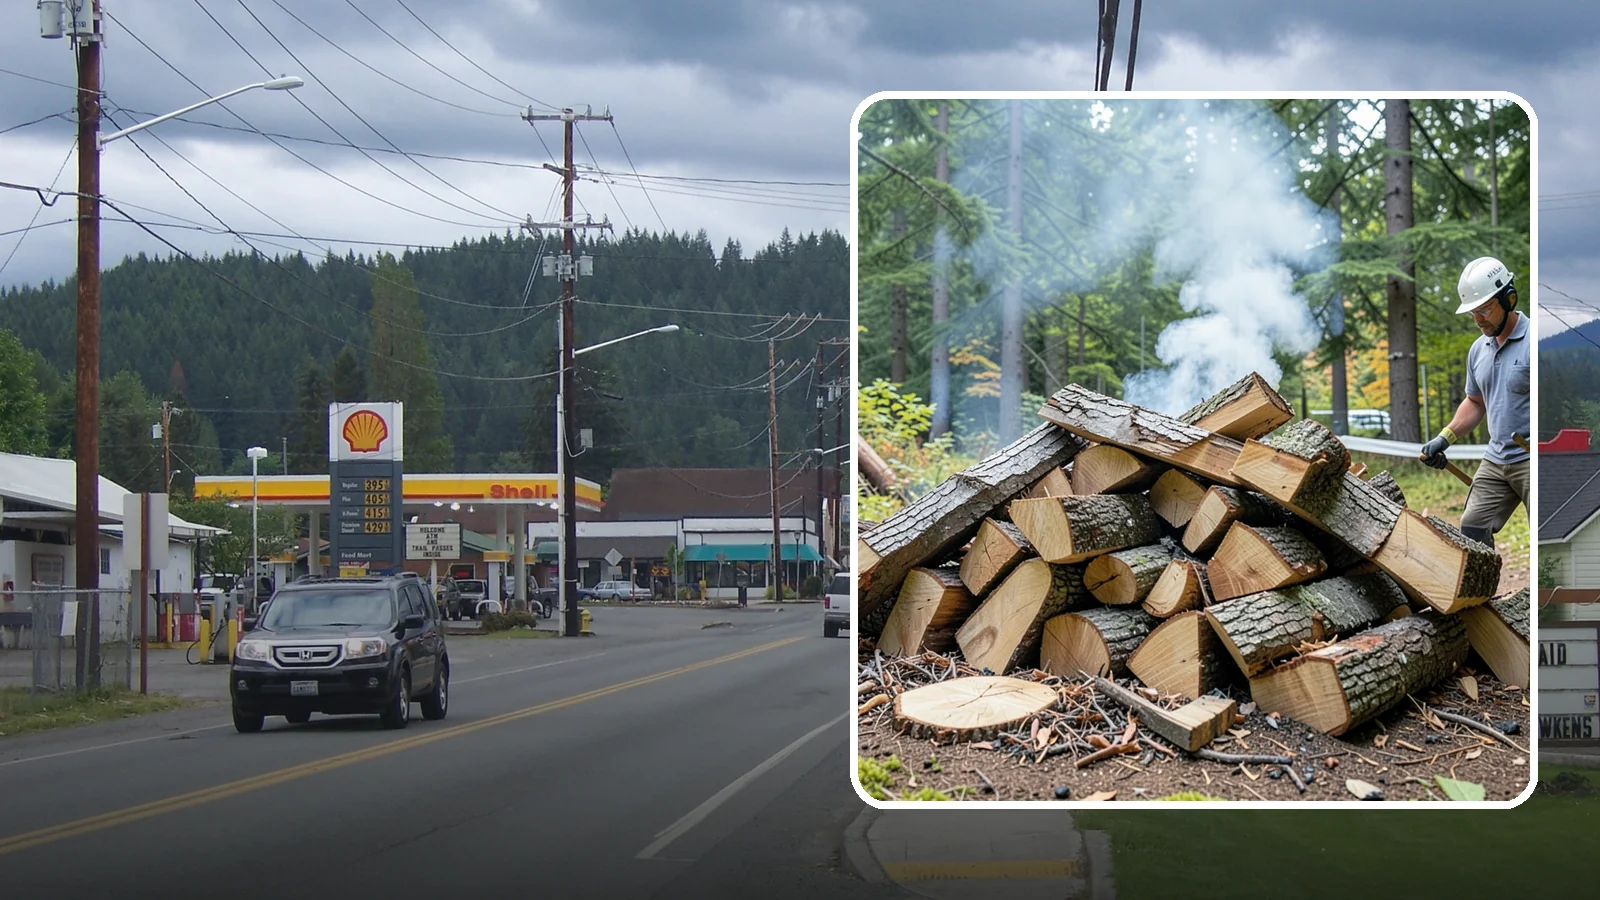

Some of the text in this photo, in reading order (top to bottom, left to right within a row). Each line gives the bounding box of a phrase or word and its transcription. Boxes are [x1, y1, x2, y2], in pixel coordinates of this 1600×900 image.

[366, 480, 383, 490] 395
[490, 484, 547, 499] Shell
[366, 494, 383, 504] 405
[366, 508, 383, 518] 415
[366, 522, 383, 532] 429
